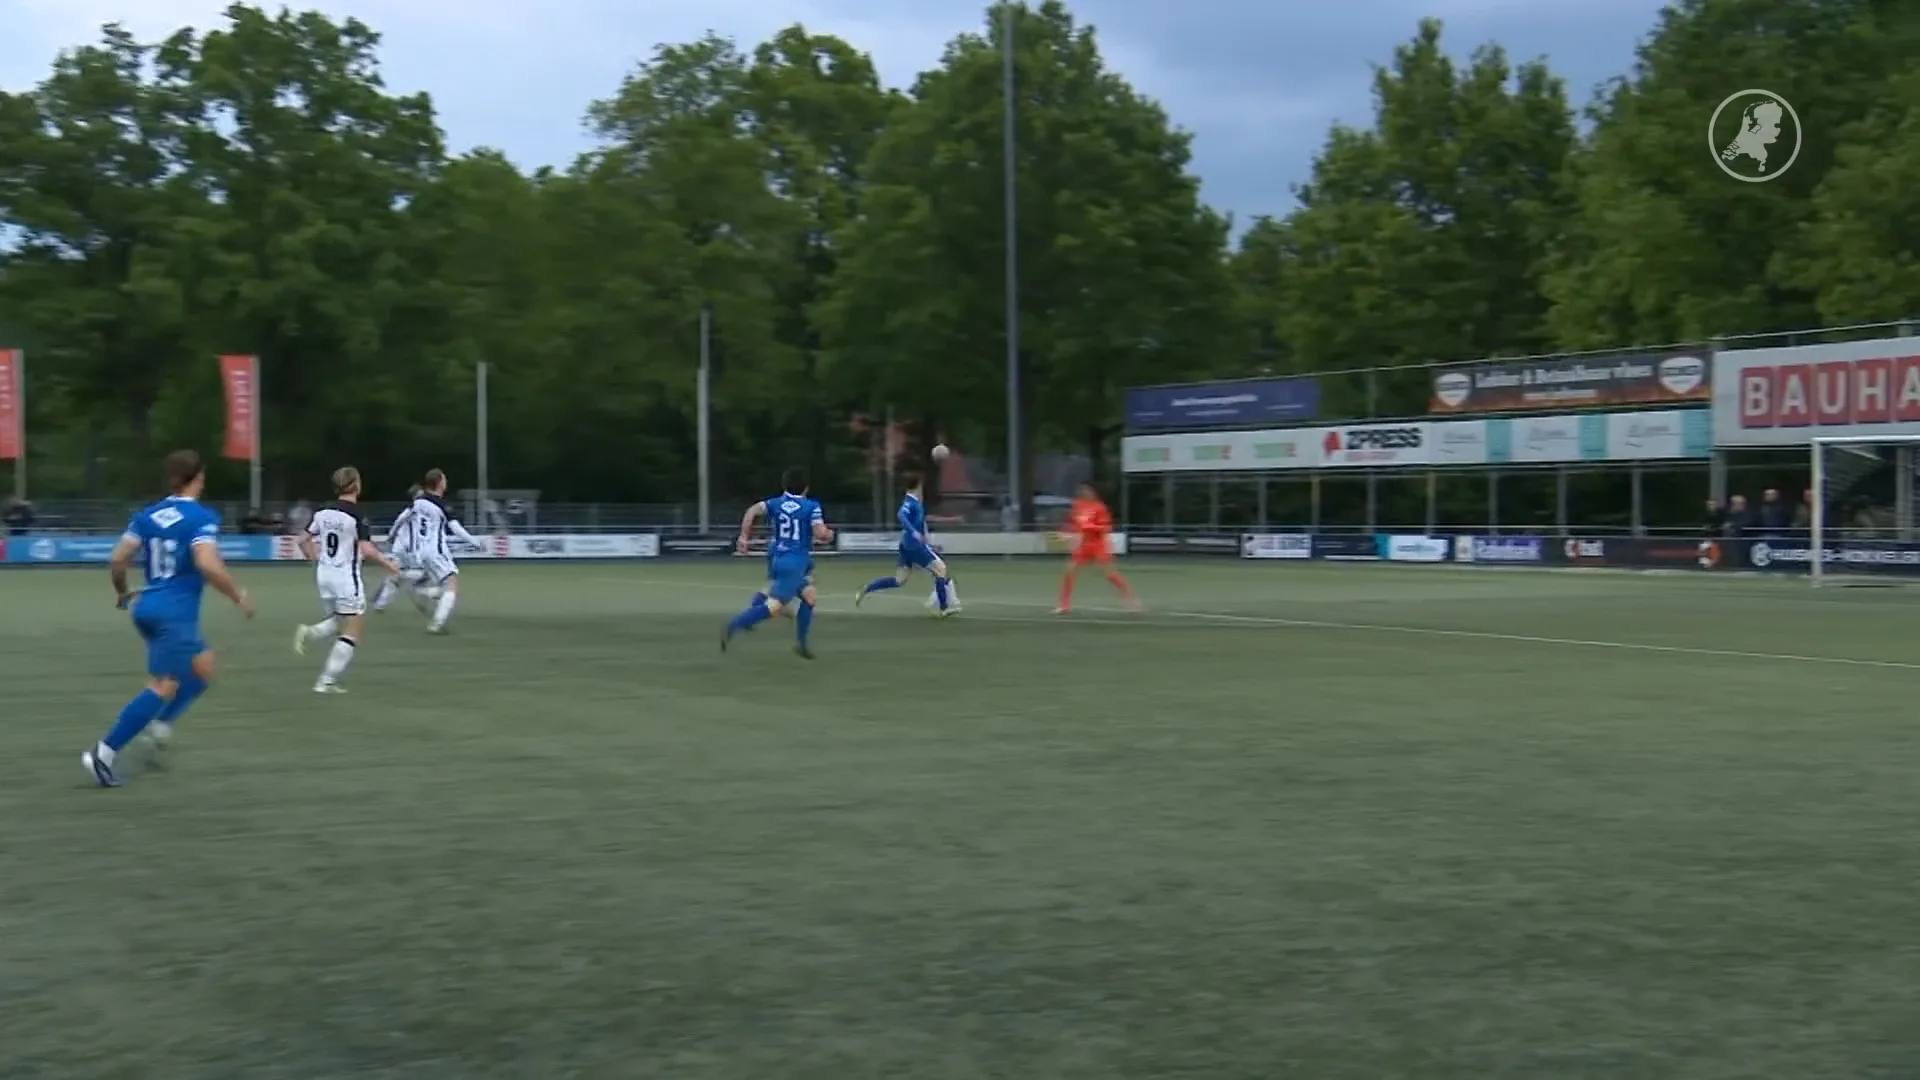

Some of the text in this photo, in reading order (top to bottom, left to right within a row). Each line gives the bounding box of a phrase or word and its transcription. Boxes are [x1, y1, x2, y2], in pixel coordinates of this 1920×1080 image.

[1743, 366, 1920, 417] BAUHA
[1345, 427, 1422, 450] ZPRESS
[777, 512, 801, 541] 21
[325, 531, 340, 558] 9
